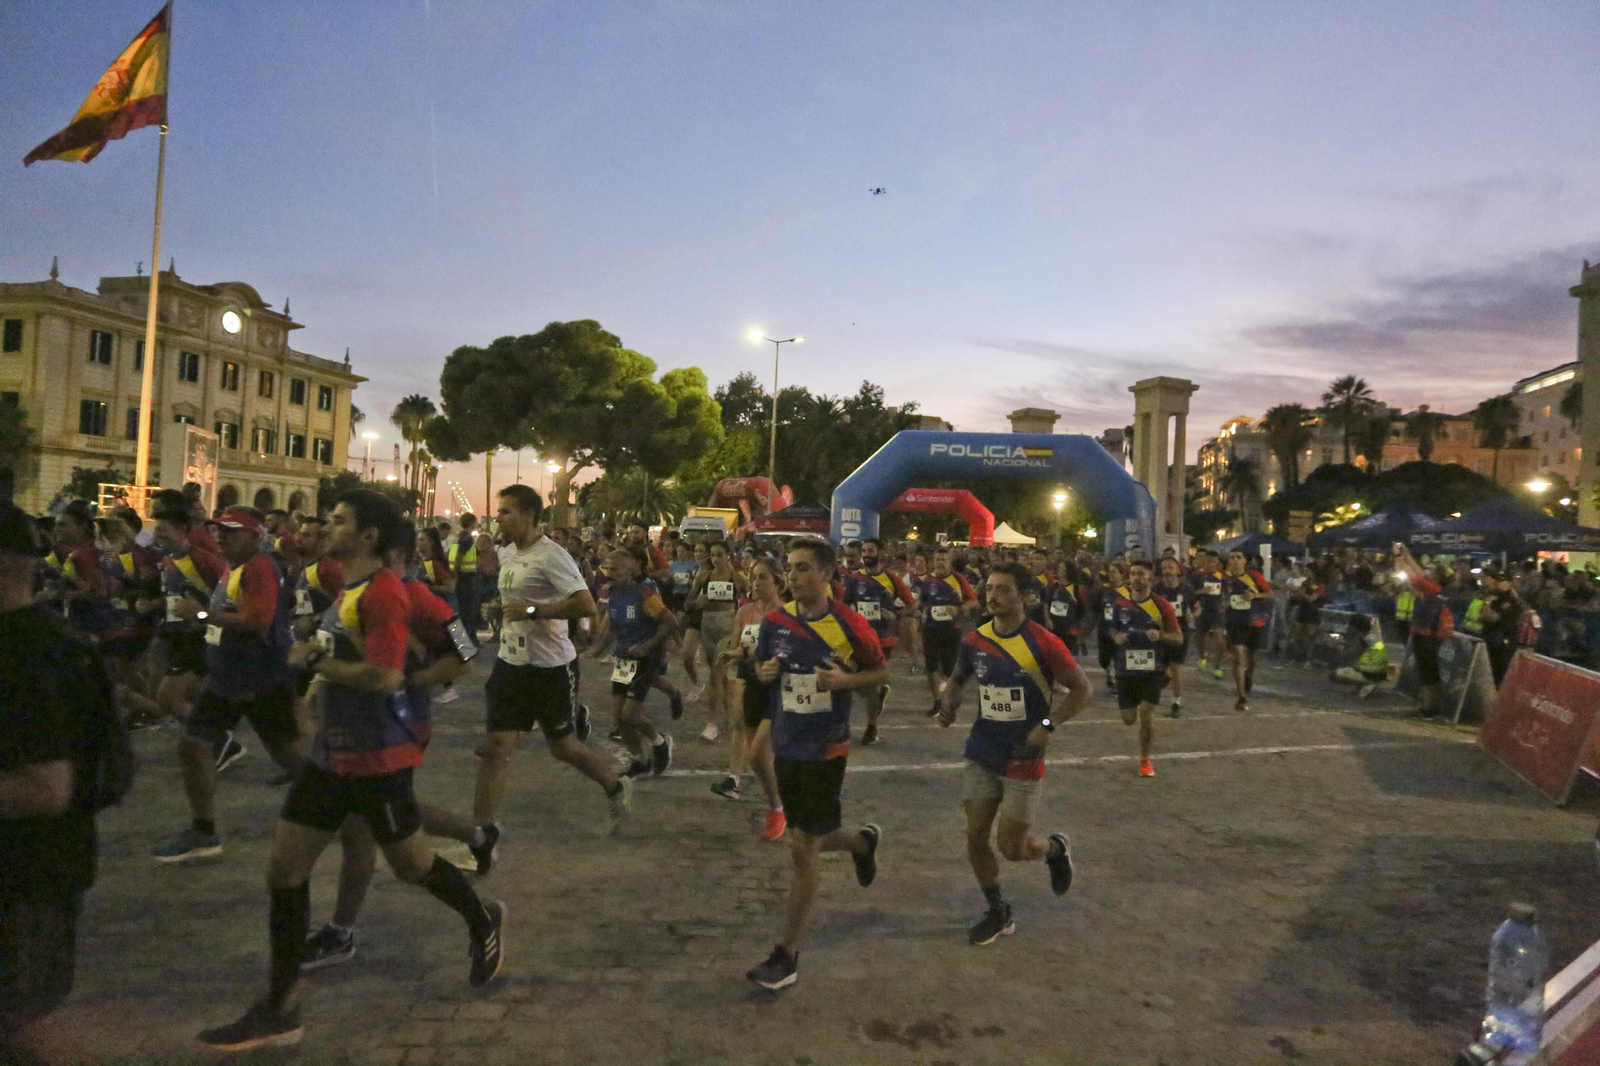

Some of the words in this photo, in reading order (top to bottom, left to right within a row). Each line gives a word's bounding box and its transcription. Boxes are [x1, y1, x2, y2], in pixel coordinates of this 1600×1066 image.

[983, 458, 1052, 468] NACIONAL
[916, 494, 955, 503] Santander
[841, 508, 861, 522] RUTA
[796, 694, 812, 705] 61
[990, 702, 1013, 713] 488
